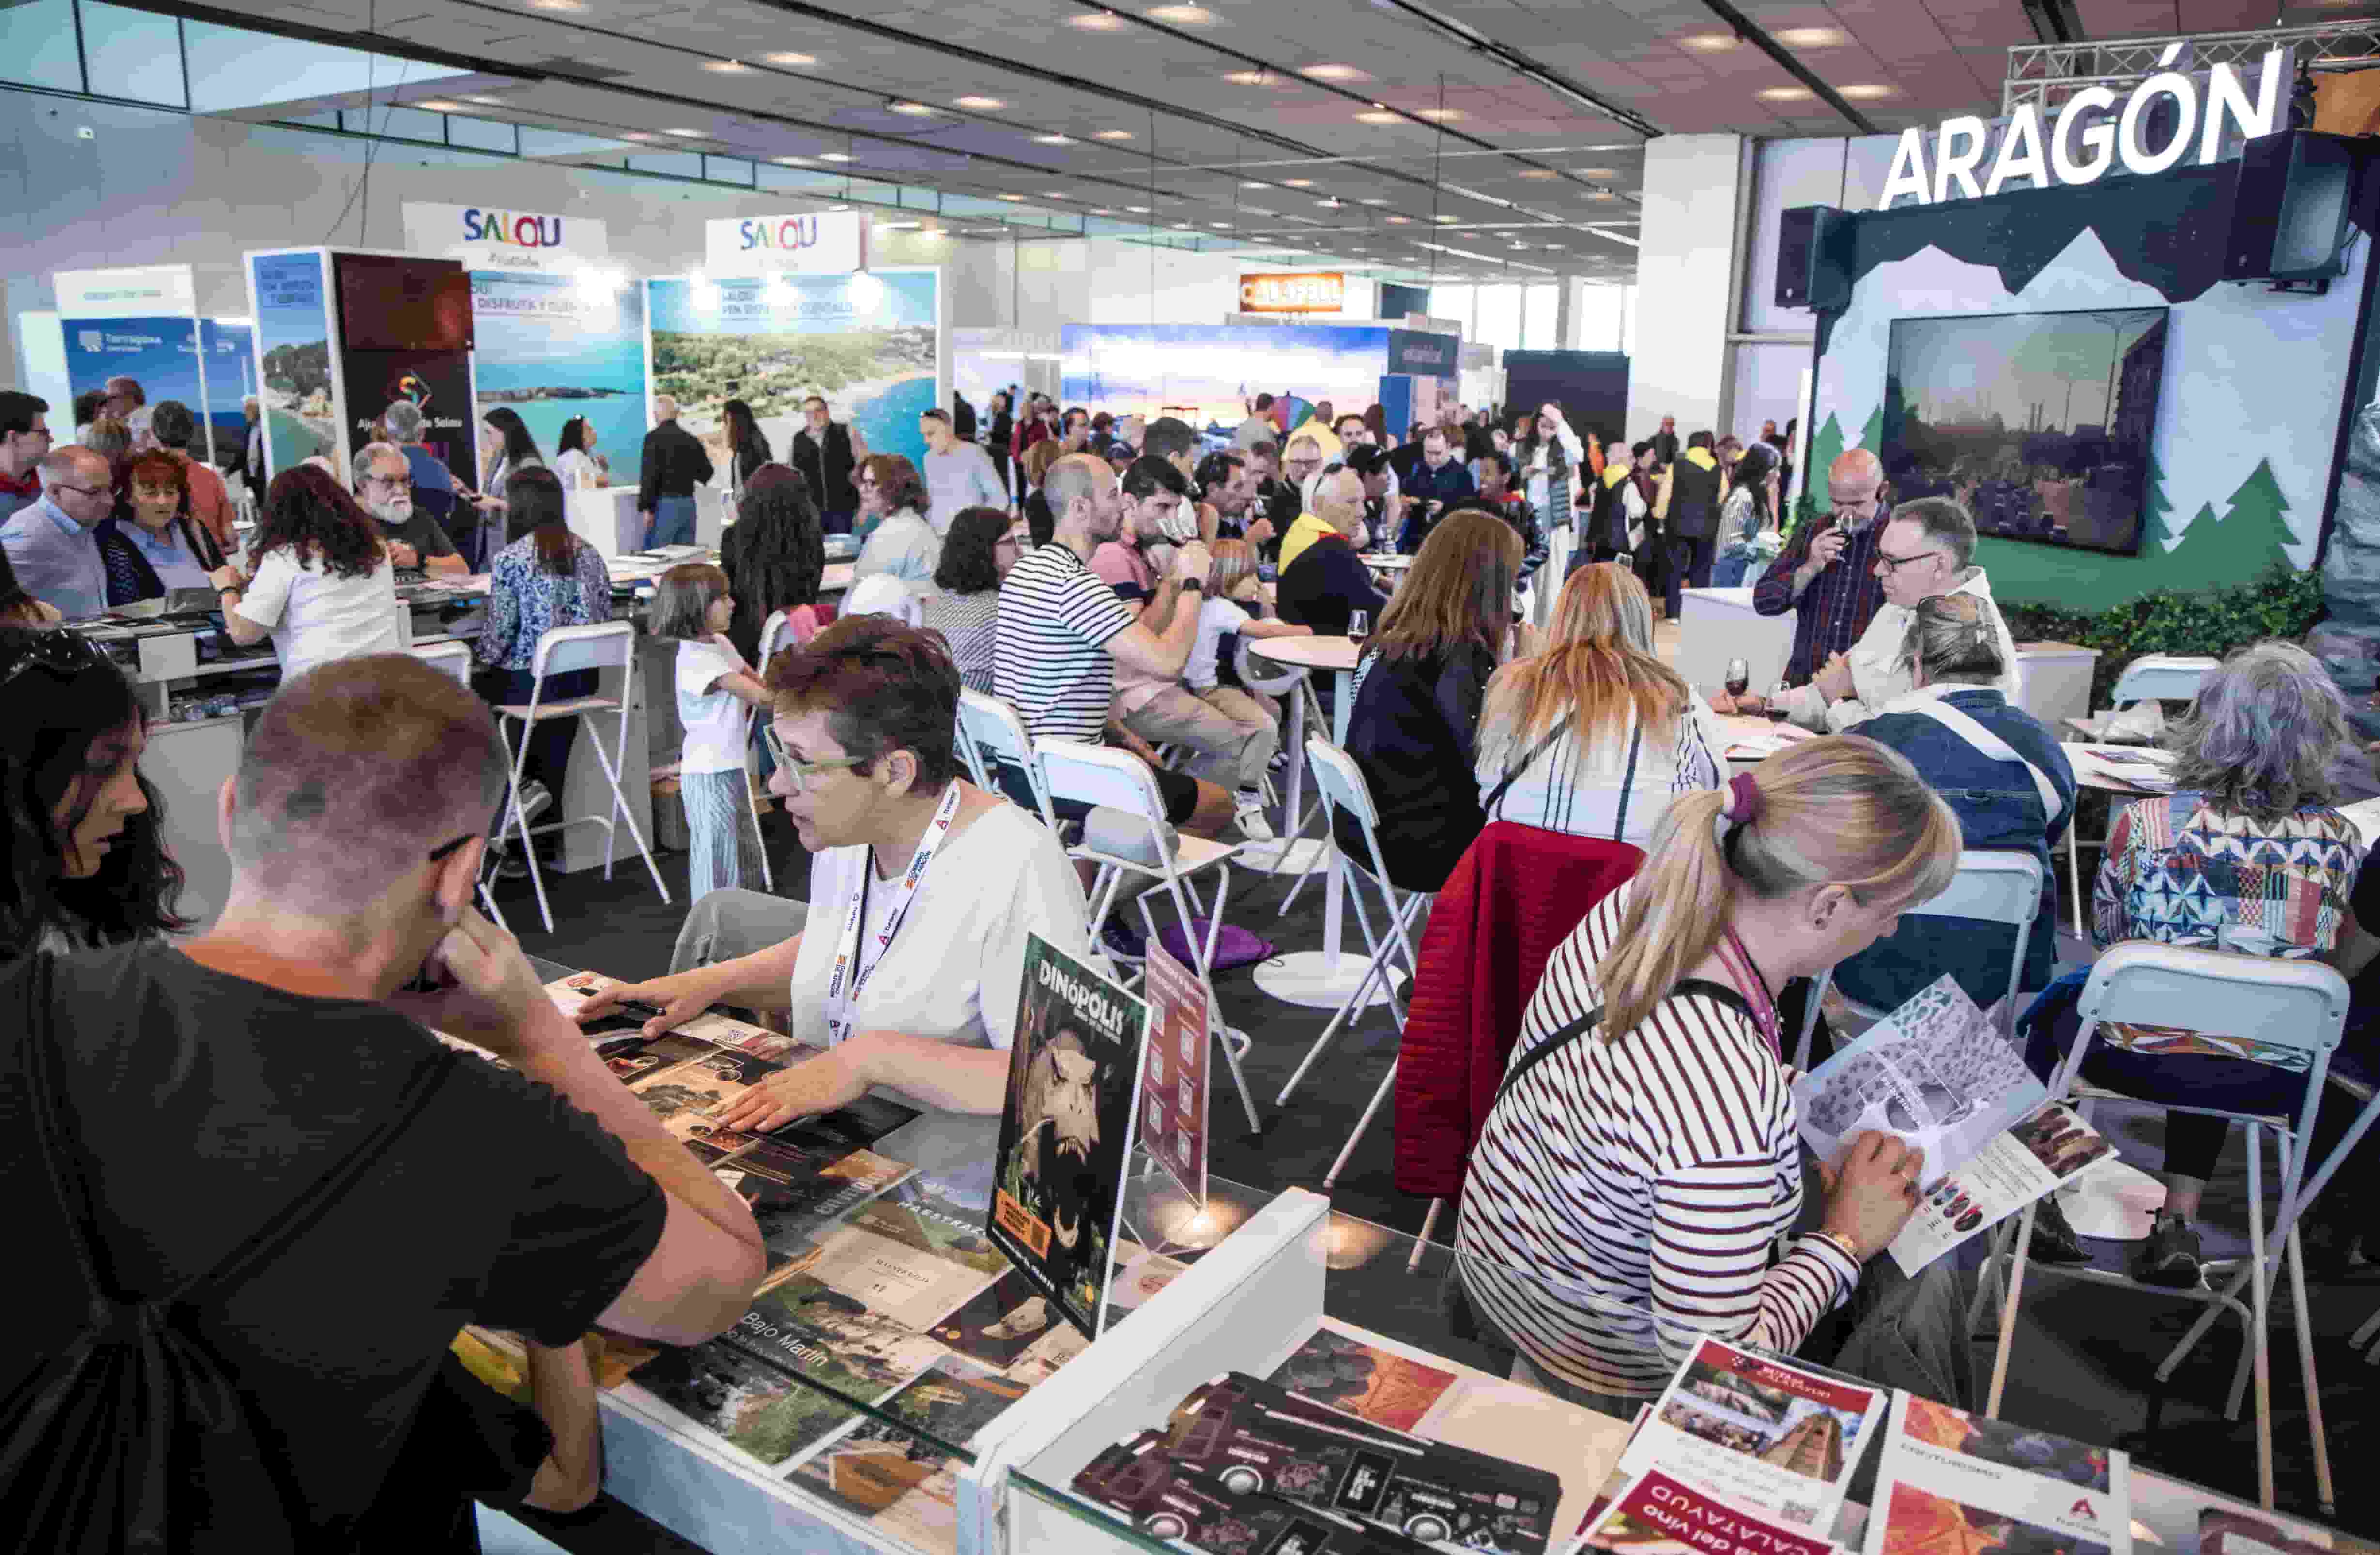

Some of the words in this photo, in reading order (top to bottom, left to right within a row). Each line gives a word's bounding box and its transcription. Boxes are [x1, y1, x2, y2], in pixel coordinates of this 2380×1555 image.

[1877, 42, 2284, 211] ARAGÓN
[463, 209, 562, 248] SALOU
[739, 216, 817, 251] SALOU
[1038, 960, 1124, 1036] DINÓPOLIS
[744, 1312, 778, 1337] Bajo
[1642, 1504, 1689, 1534] vino
[1691, 1530, 1730, 1552] del
[1650, 1485, 1809, 1555] CALATAYUD
